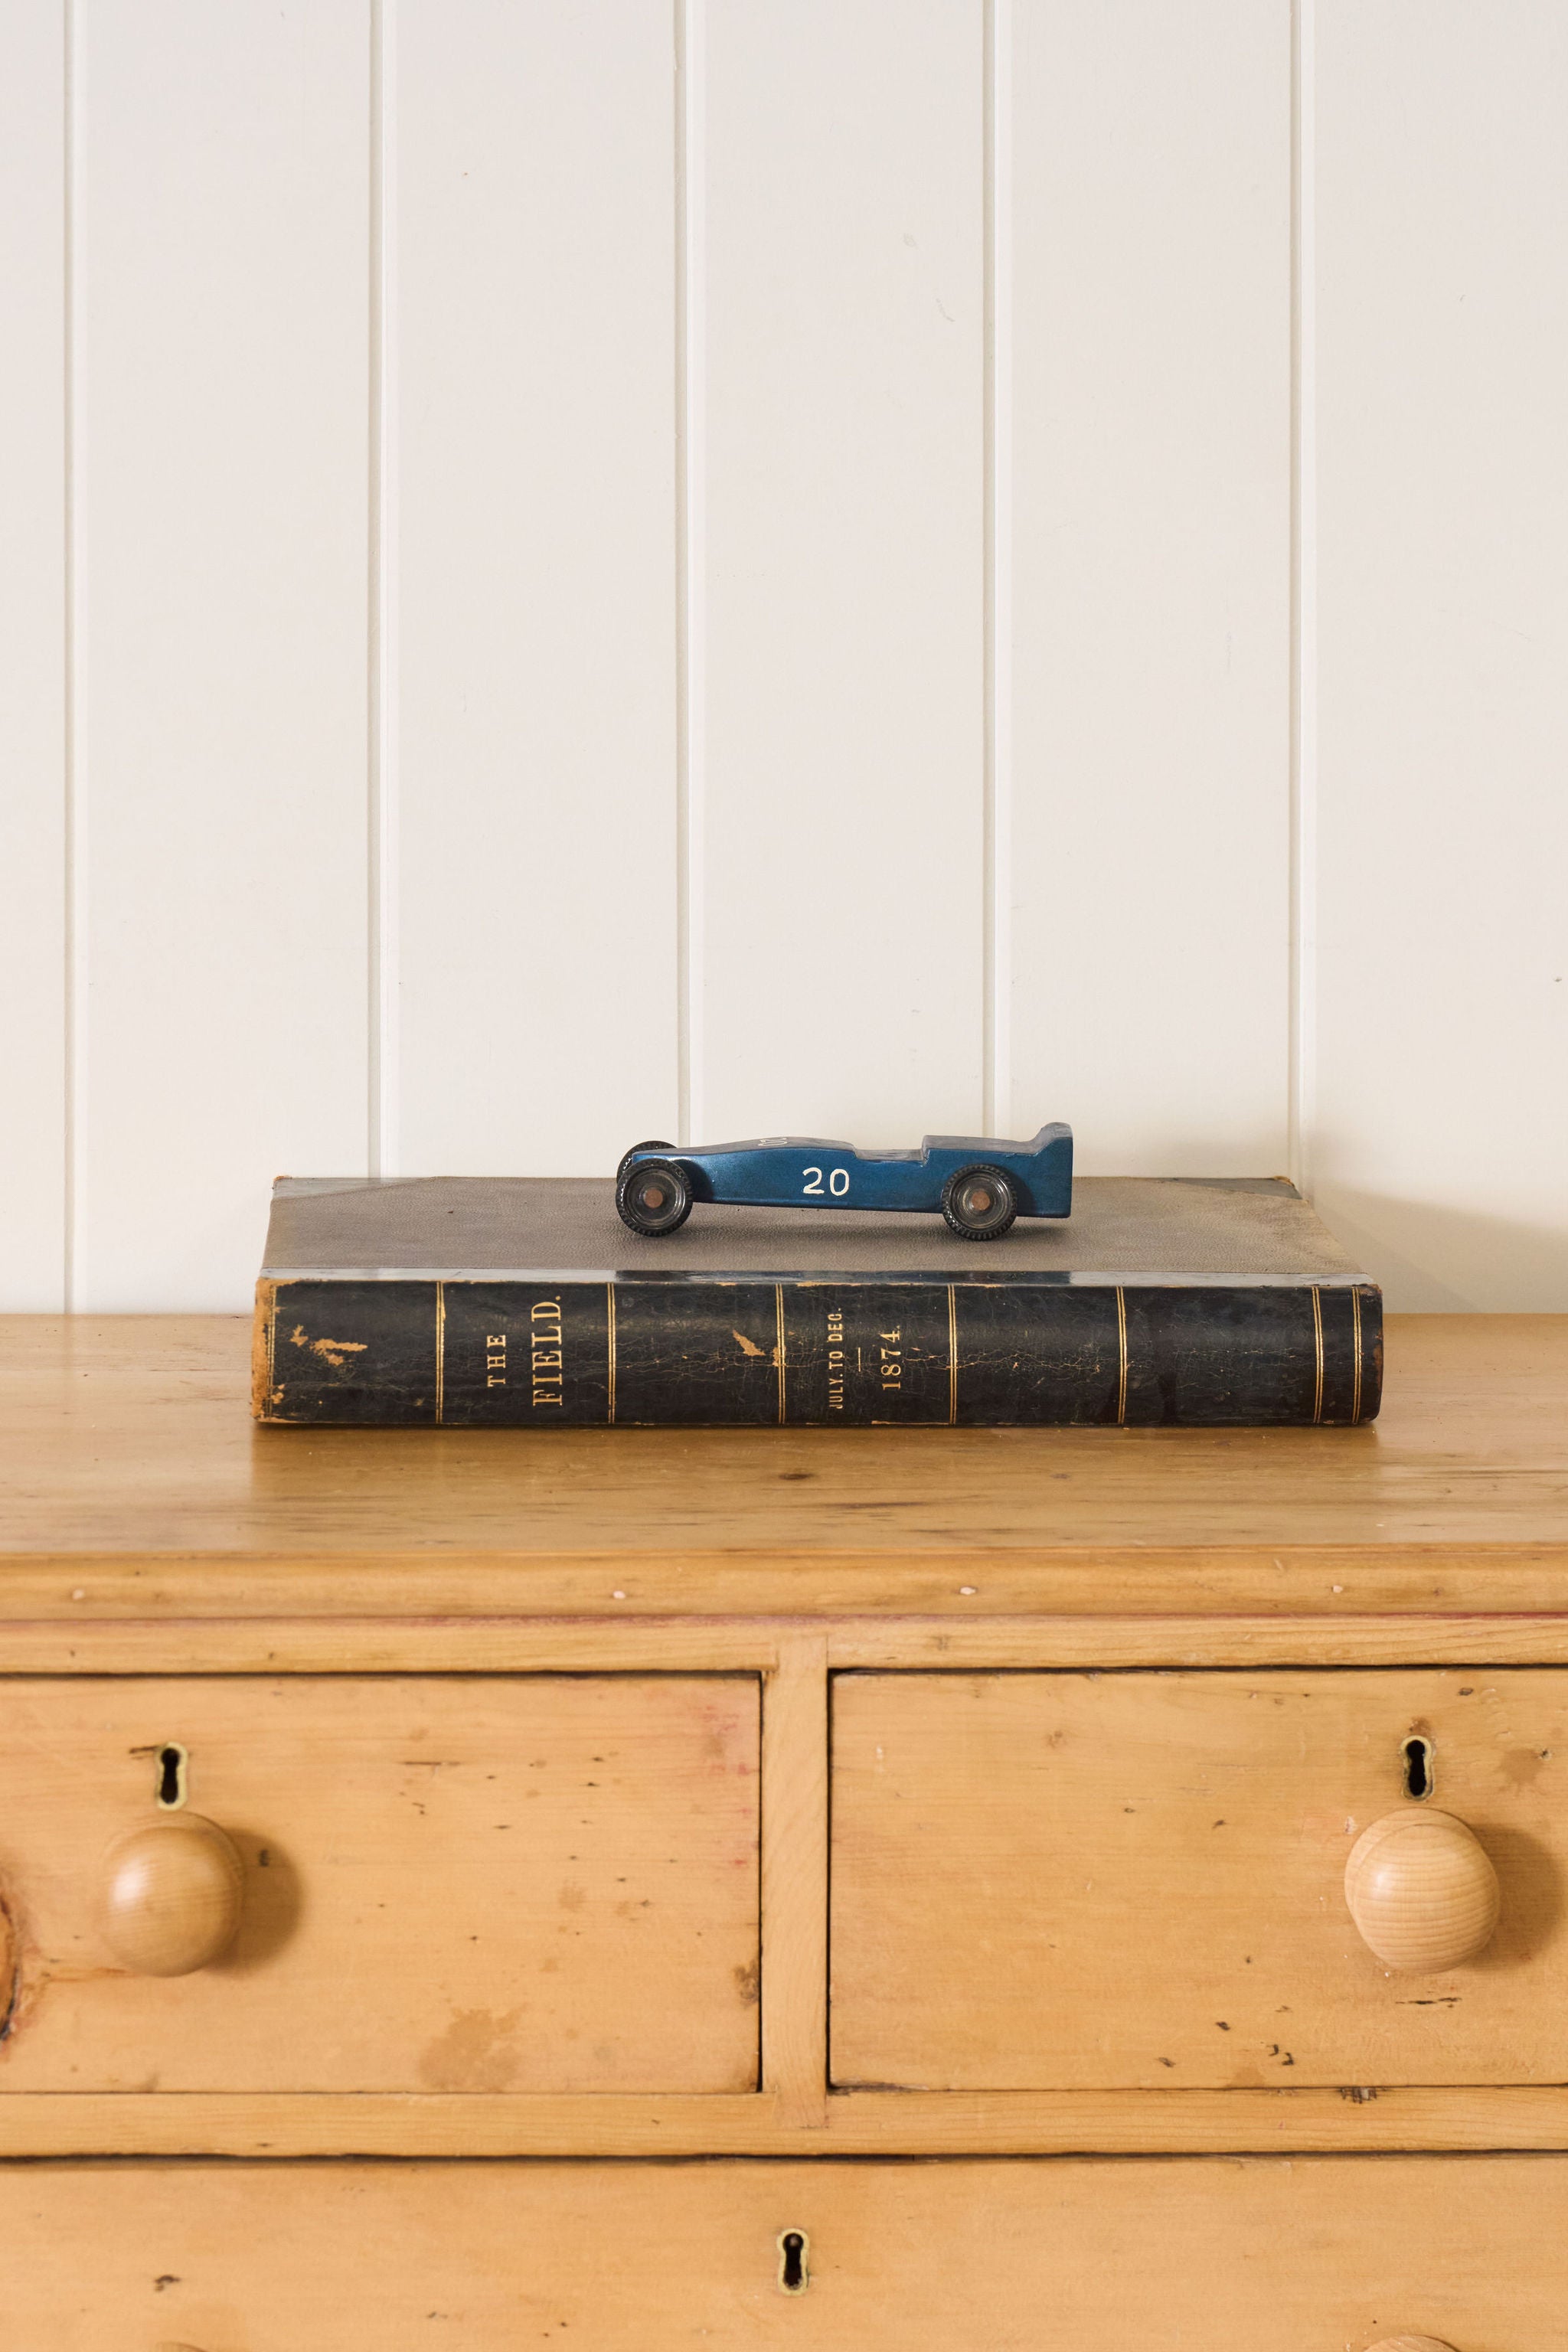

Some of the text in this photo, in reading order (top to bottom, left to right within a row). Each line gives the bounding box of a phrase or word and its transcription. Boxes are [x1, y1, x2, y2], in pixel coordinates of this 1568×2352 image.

[802, 1167, 850, 1196] 20
[827, 1308, 843, 1342] DEC.
[486, 1334, 506, 1387] THE
[531, 1295, 562, 1406] FIELD.
[828, 1351, 844, 1370] TO
